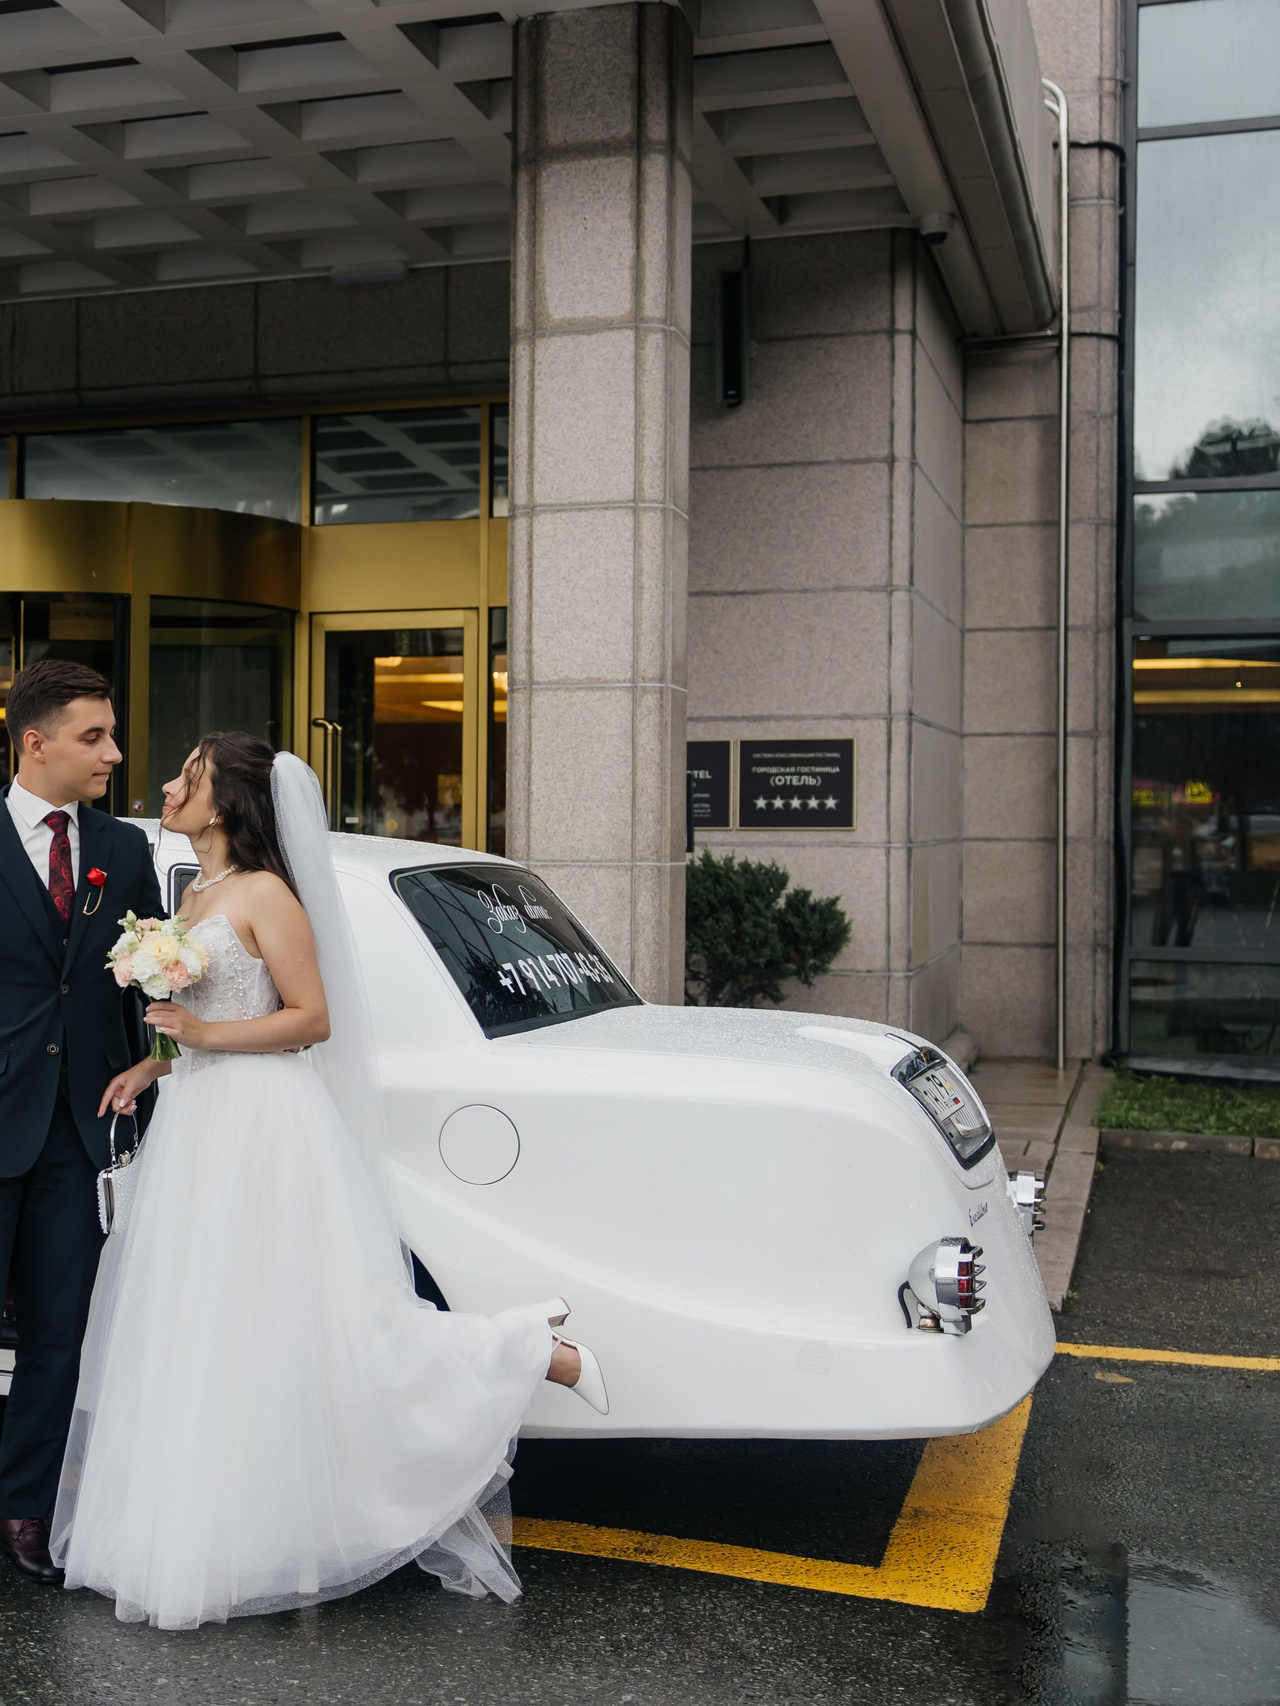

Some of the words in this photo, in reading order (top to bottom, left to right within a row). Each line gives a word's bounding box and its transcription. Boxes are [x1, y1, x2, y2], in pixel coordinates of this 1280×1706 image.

[752, 766, 795, 774] ГОРОДСКАЯ
[797, 766, 841, 774] ГОСТИНИЦА
[769, 775, 822, 787] (ОТЕЛЬ)
[497, 962, 527, 996] +7
[517, 956, 561, 992] 914
